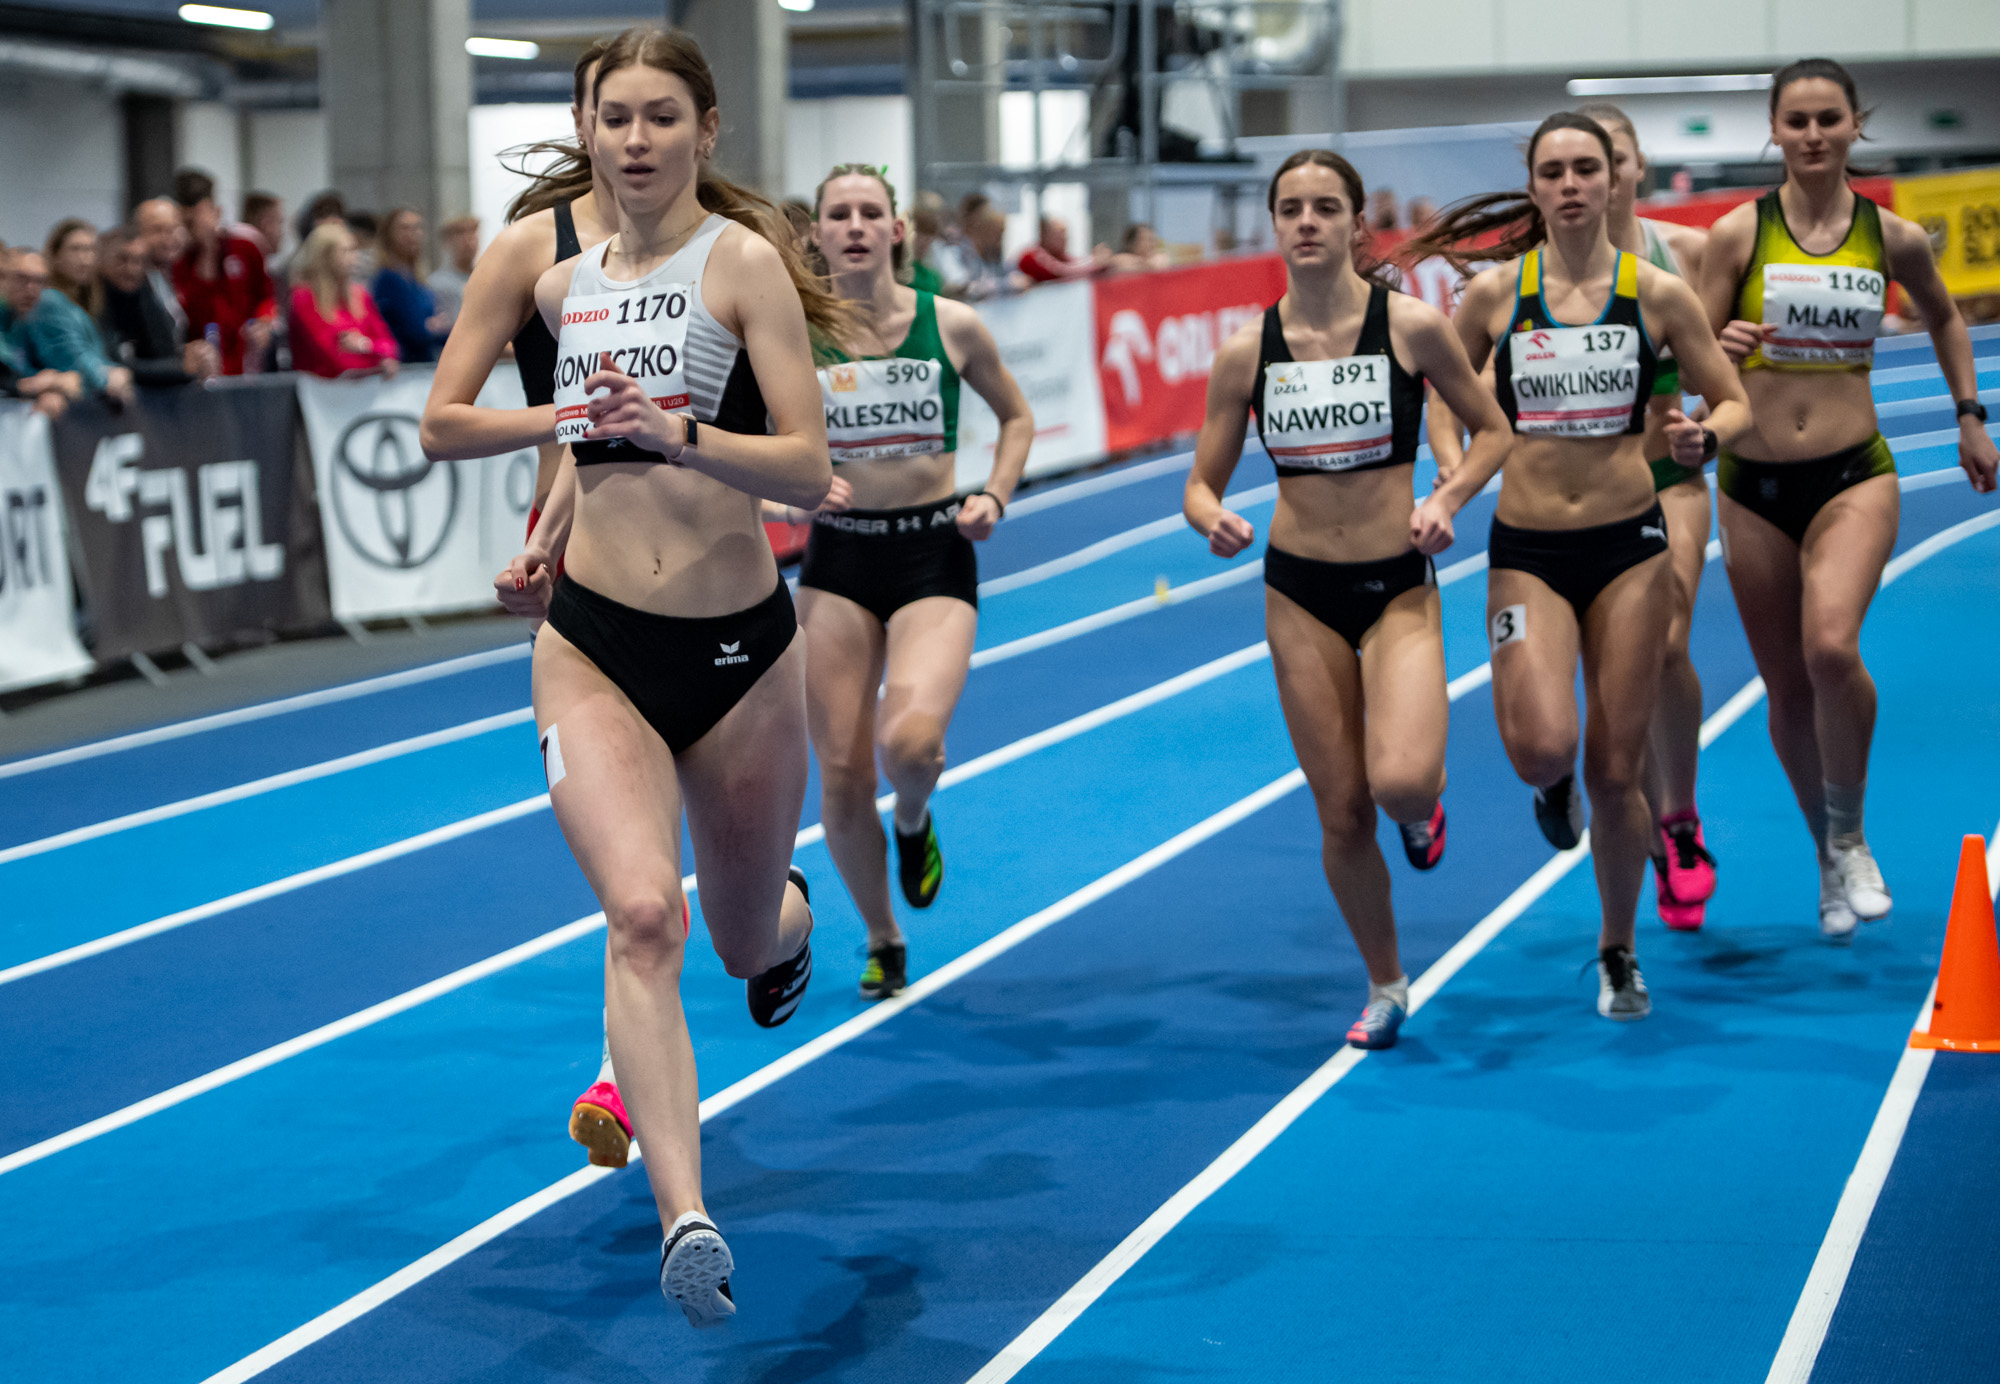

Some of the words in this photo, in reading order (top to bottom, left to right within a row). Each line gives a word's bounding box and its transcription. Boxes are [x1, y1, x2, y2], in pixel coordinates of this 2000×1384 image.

[1829, 271, 1881, 296] 1160
[616, 292, 687, 325] 1170
[1787, 303, 1860, 329] MLAK
[1582, 331, 1626, 352] 137
[886, 363, 930, 385] 590
[1332, 363, 1377, 385] 891
[1517, 365, 1634, 398] ĆWIKLIŃSKA
[1274, 383, 1308, 395] DZLA
[826, 399, 939, 429] KLESZNO
[1267, 401, 1386, 434] NAWROT
[1496, 610, 1515, 644] 3
[714, 653, 750, 667] erima
